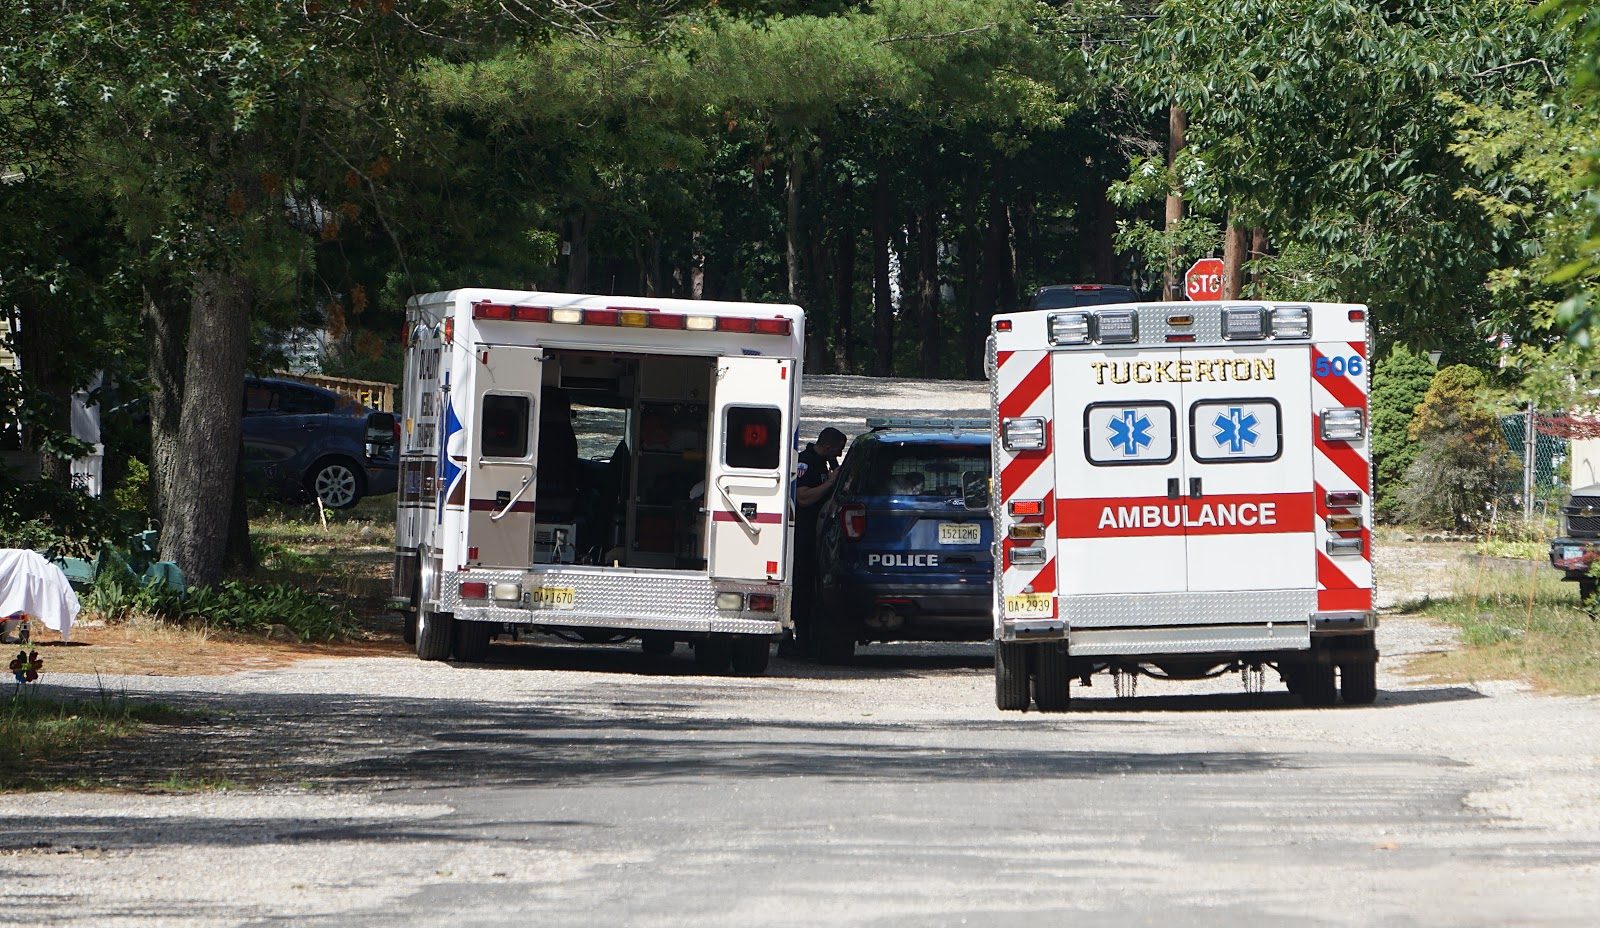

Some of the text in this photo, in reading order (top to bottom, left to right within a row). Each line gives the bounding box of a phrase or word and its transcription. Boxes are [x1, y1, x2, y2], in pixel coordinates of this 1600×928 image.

[1190, 274, 1223, 293] STO
[1091, 358, 1276, 385] TUCKERTON
[1315, 355, 1364, 377] 506
[1098, 502, 1277, 529] AMBULANCE
[941, 528, 978, 540] 15212MG
[868, 554, 939, 567] POLICE
